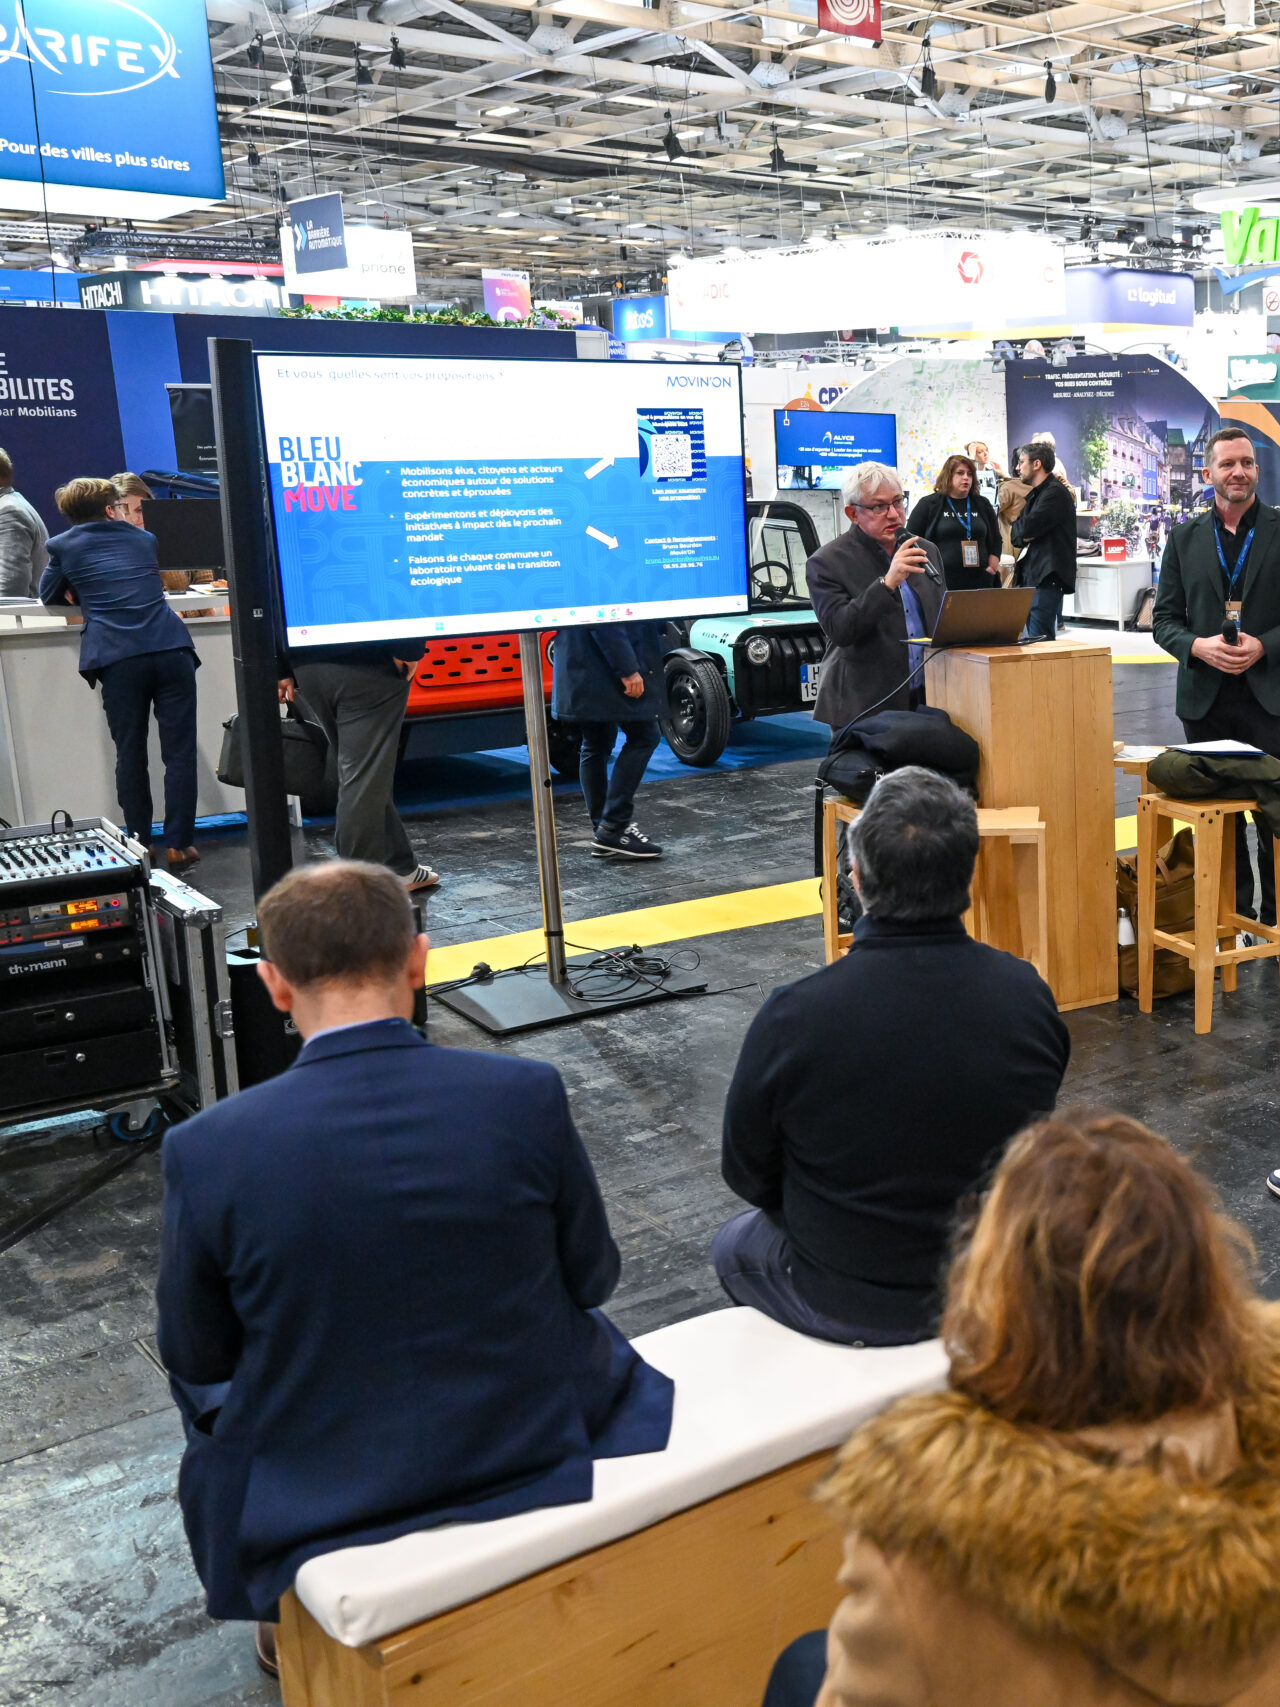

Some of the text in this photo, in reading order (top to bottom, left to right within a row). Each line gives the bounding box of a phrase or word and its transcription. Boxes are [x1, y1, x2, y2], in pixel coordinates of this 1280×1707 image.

[0, 0, 182, 79] ARIFEX
[0, 138, 191, 171] Pour des villes plus sûres
[81, 281, 123, 309] HITACHI
[1138, 285, 1177, 306] logitud
[277, 369, 288, 378] Et
[329, 369, 371, 381] quelles
[374, 371, 398, 380] sont
[425, 371, 495, 382] propositions
[667, 376, 731, 388] MOVIN'ON
[18, 405, 77, 417] Mobilians
[279, 437, 341, 461] BLEU
[281, 461, 363, 488] BLANC
[401, 467, 453, 476] Mobilisons
[455, 465, 476, 475] élus,
[478, 466, 517, 475] citoyens
[530, 465, 563, 473] acteurs
[402, 475, 554, 488] économiques autour de solutions
[284, 482, 357, 513] MOVE
[403, 487, 511, 498] concrètes et éprouvées
[405, 508, 553, 521] Expérimentons et déployons des
[406, 517, 562, 531] initiatives à impact dès le prochain
[407, 533, 444, 542] mandat
[409, 555, 445, 564] Faisons
[446, 554, 458, 562] de
[460, 553, 493, 564] chaque
[495, 551, 539, 560] commune
[410, 560, 561, 575] laboratoire vivant de la transition
[411, 576, 462, 587] écologique
